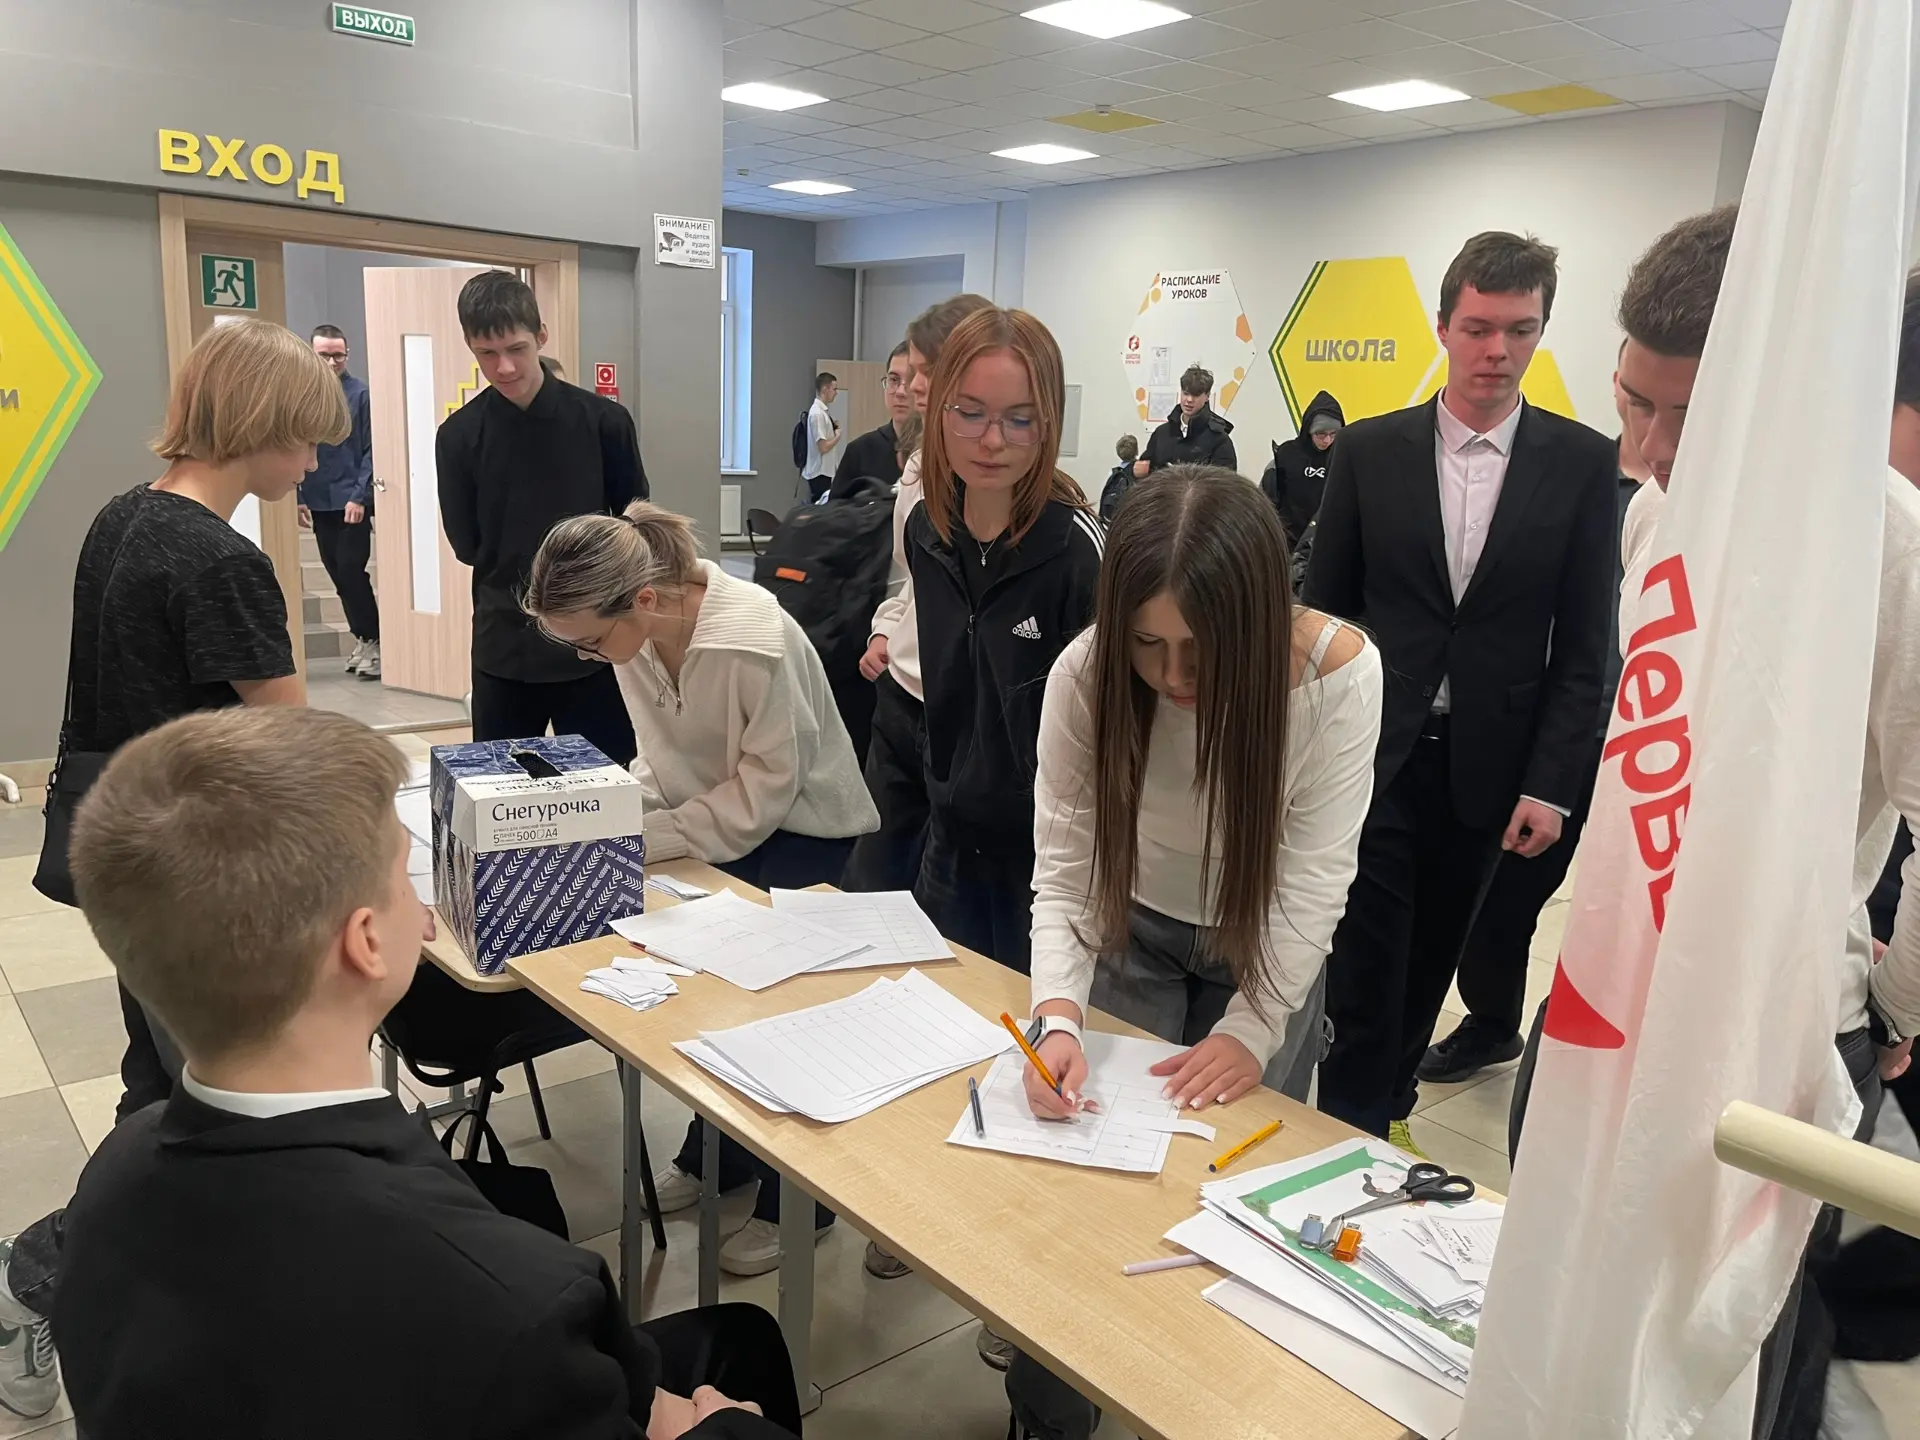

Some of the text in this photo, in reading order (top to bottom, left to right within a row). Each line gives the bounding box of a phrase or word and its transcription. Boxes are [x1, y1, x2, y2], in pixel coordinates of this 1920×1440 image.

[341, 9, 408, 38] ВЫХОД
[158, 128, 345, 204] ВХОД
[659, 218, 710, 230] ВНИМАНИЕ!
[1161, 274, 1221, 287] РАСПИСАНИЕ
[1171, 288, 1208, 300] УРОКОВ
[1012, 627, 1042, 639] adidas
[1602, 553, 1698, 935] Перв
[492, 799, 601, 822] Снегурочка
[494, 834, 500, 844] 5
[516, 830, 536, 841] 500
[545, 828, 558, 838] А4
